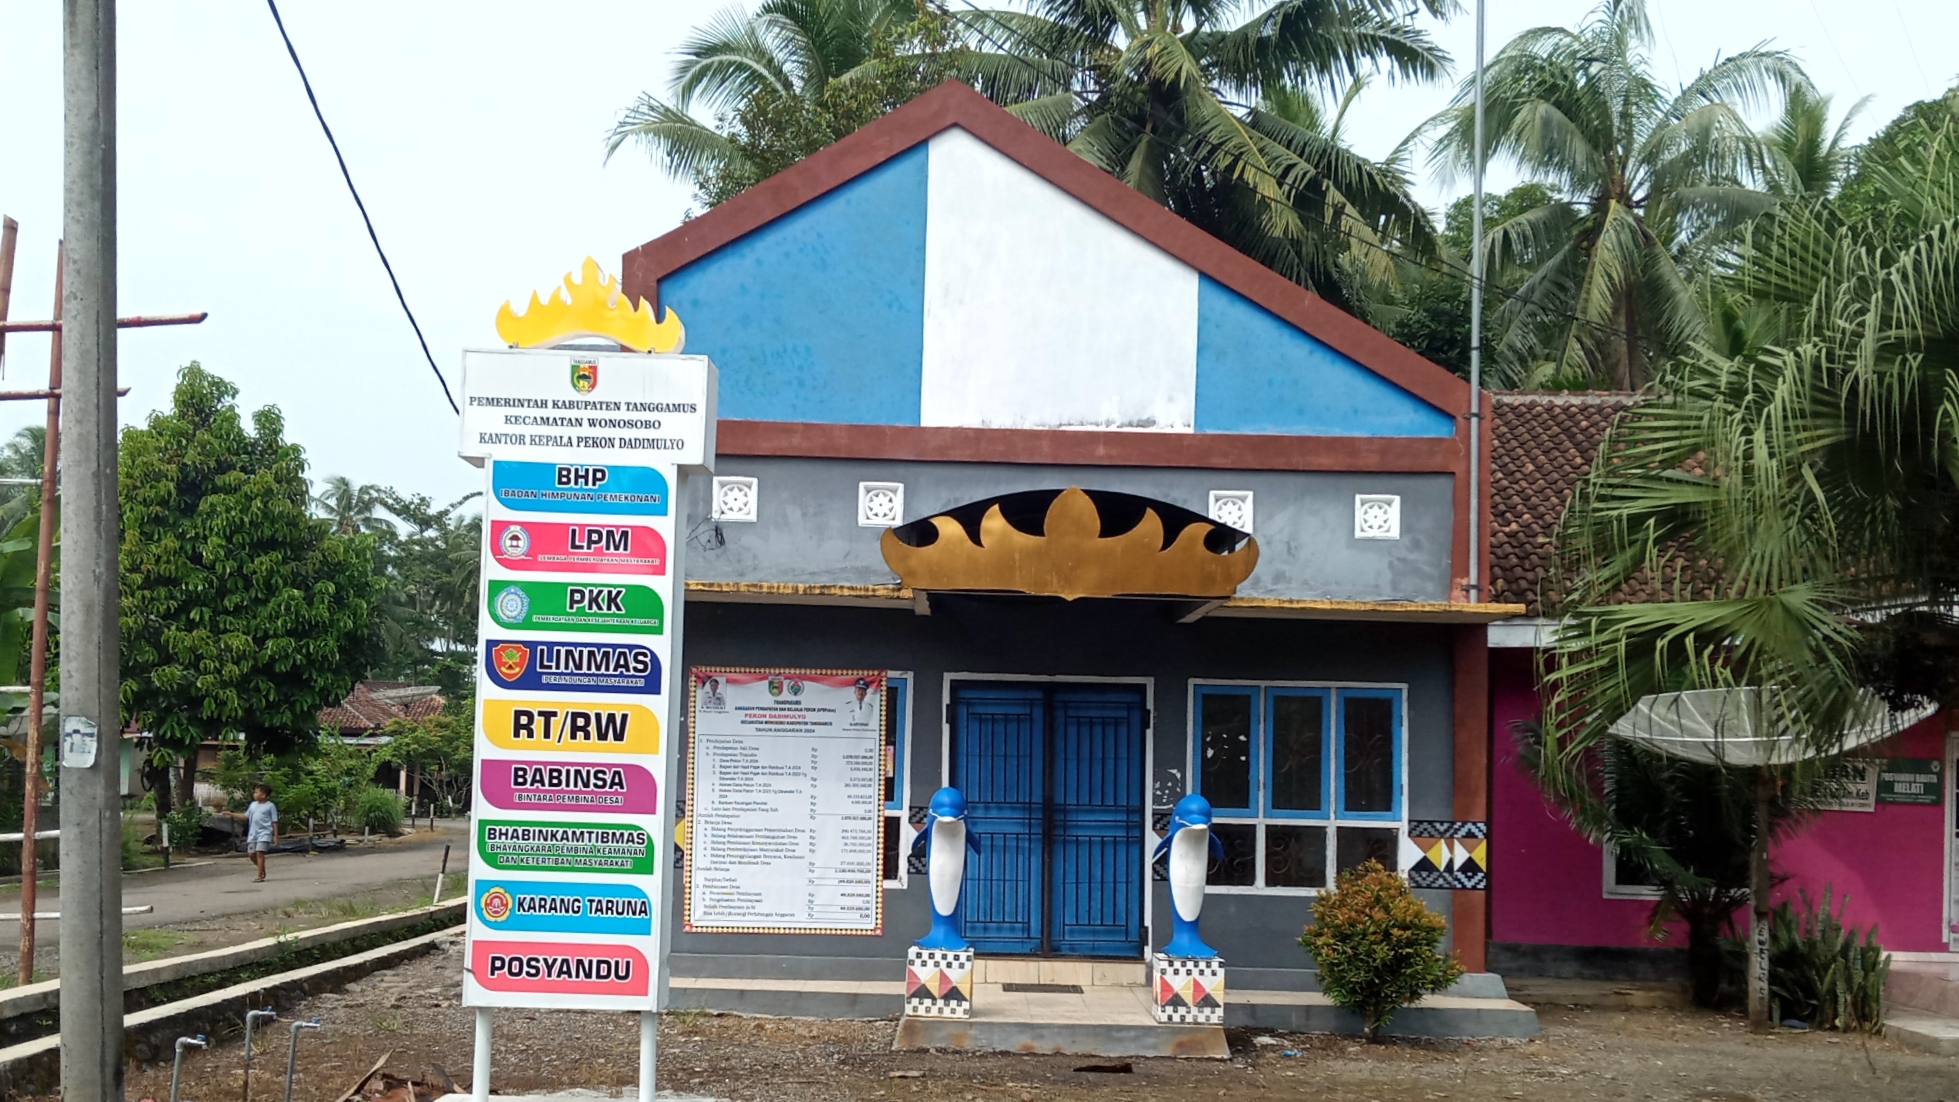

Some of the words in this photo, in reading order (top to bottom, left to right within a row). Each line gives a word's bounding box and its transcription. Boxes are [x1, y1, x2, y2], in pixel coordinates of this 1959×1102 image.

[468, 396, 548, 409] PEMERINTAH
[552, 399, 621, 412] KABUPATEN
[624, 402, 697, 414] TANGGAMUS
[504, 415, 583, 428] KECAMATAN
[587, 418, 661, 430] WONOSOBO
[479, 432, 526, 446] KANTOR
[529, 434, 573, 448] KEPALA
[576, 436, 615, 448] PEKON
[619, 438, 685, 450] DADIMULYO
[556, 466, 607, 487] BHP
[540, 492, 594, 501] HIMPUNAN
[570, 528, 630, 552] LPM
[568, 589, 624, 612] PKK
[538, 648, 650, 674] LINMAS
[512, 709, 629, 744] RT/RW
[512, 766, 625, 790] BABINSA
[1894, 782, 1924, 794] MELATI
[556, 795, 595, 804] PEMBINA
[487, 828, 646, 845] BHABINKAMTIBMAS
[555, 846, 594, 855] PEMBINA
[596, 848, 645, 857] KEAMANAN
[498, 856, 517, 864] DAN
[520, 857, 572, 866] KETERTIBAN
[517, 896, 582, 915] KARANG
[587, 899, 649, 917] TARUNA
[489, 956, 632, 981] POSYANDU
